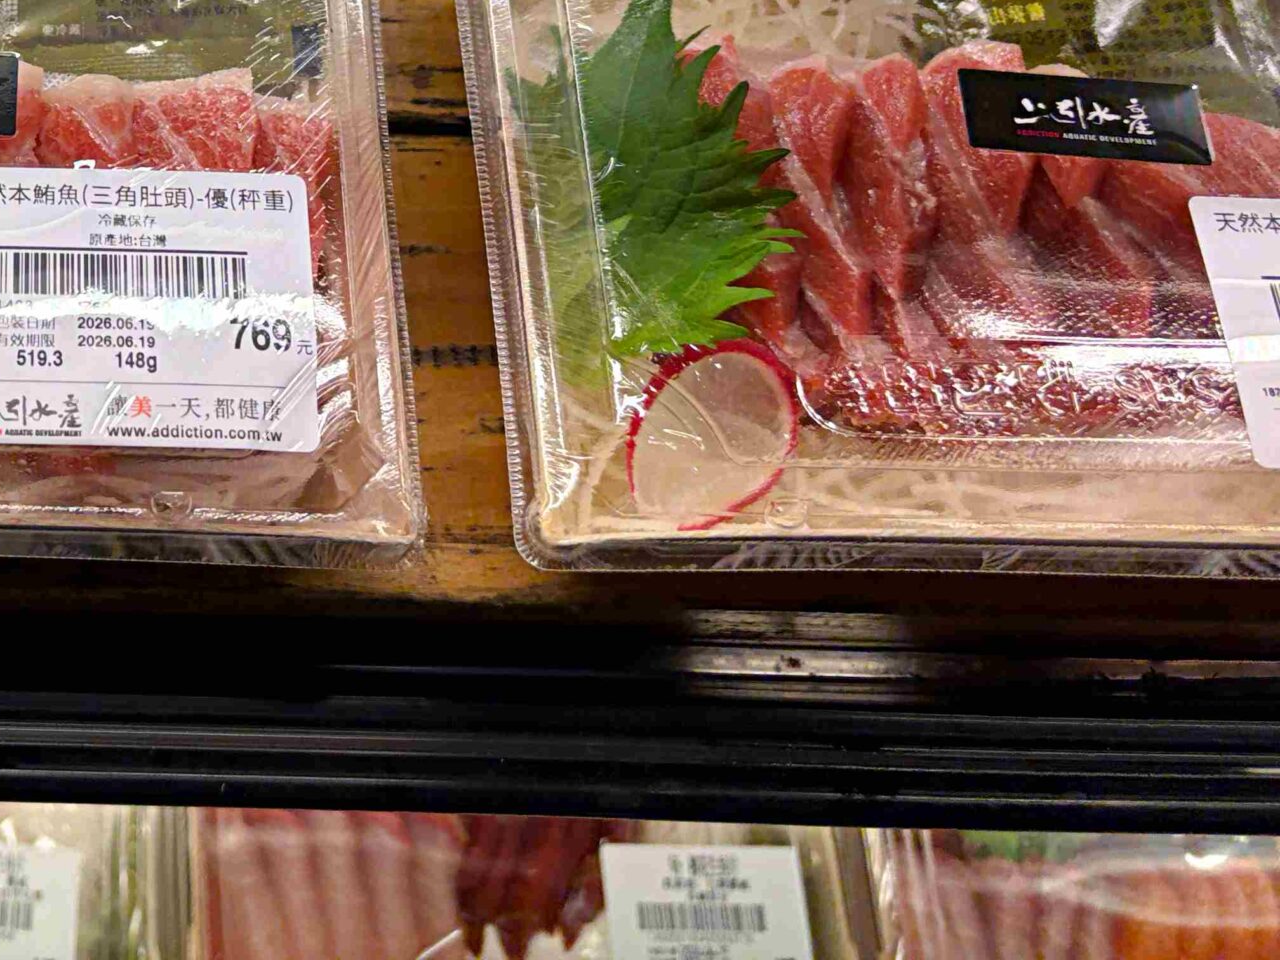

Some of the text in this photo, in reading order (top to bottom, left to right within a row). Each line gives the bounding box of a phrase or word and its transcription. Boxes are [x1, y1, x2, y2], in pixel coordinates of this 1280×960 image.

[1062, 133, 1097, 141] AQUATIC
[97, 213, 156, 228] 冷藏保存
[1213, 212, 1280, 234] 天然本
[89, 233, 167, 248] 原產地:台灣
[77, 335, 156, 349] 2026.06.19
[229, 317, 314, 356] 769 元
[16, 350, 63, 367] 519.3
[114, 352, 157, 373] 148g
[35, 429, 82, 438] DEVELOPMENT
[107, 425, 282, 442] www.addiction.com.tw
